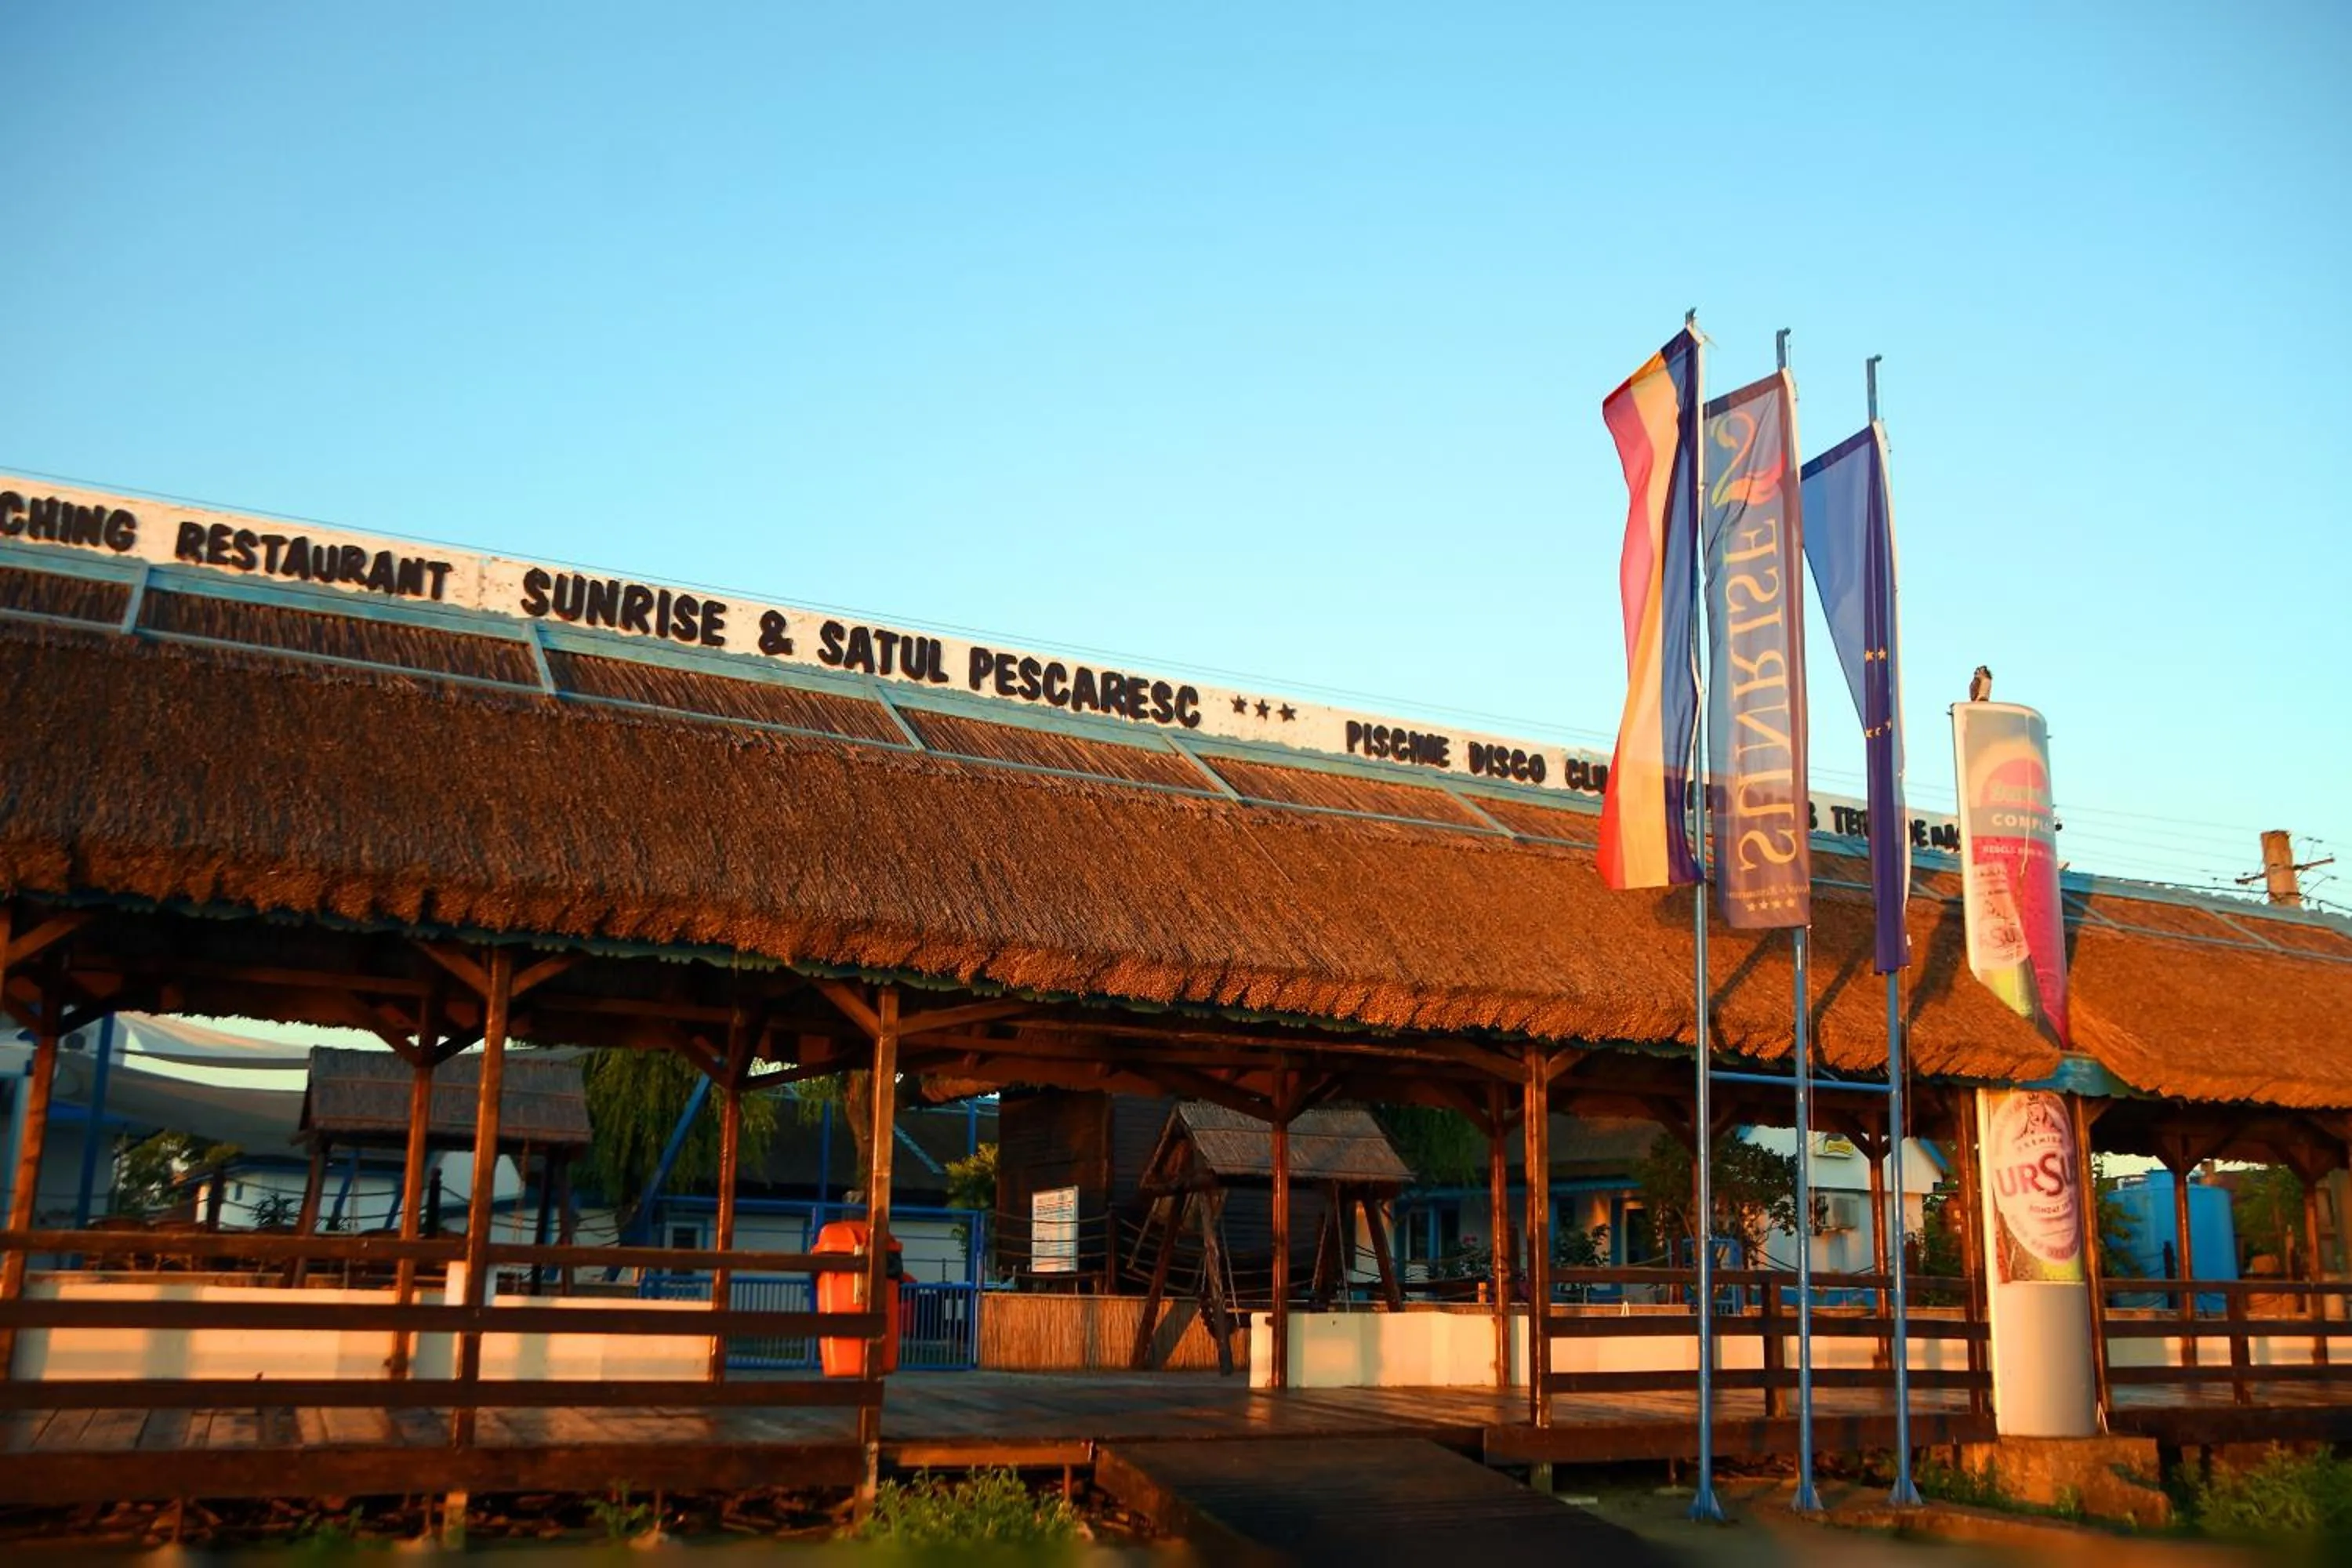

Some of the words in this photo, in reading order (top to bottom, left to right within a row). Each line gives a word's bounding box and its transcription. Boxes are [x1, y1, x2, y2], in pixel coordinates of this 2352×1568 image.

[0, 491, 136, 552] CHING
[175, 521, 452, 601] RESTAURANT
[521, 567, 727, 647] SUNRISE
[758, 609, 793, 656] &
[818, 620, 949, 682] SATUL
[968, 647, 1201, 728] PESCARESC
[1468, 742, 1546, 784] DISCO
